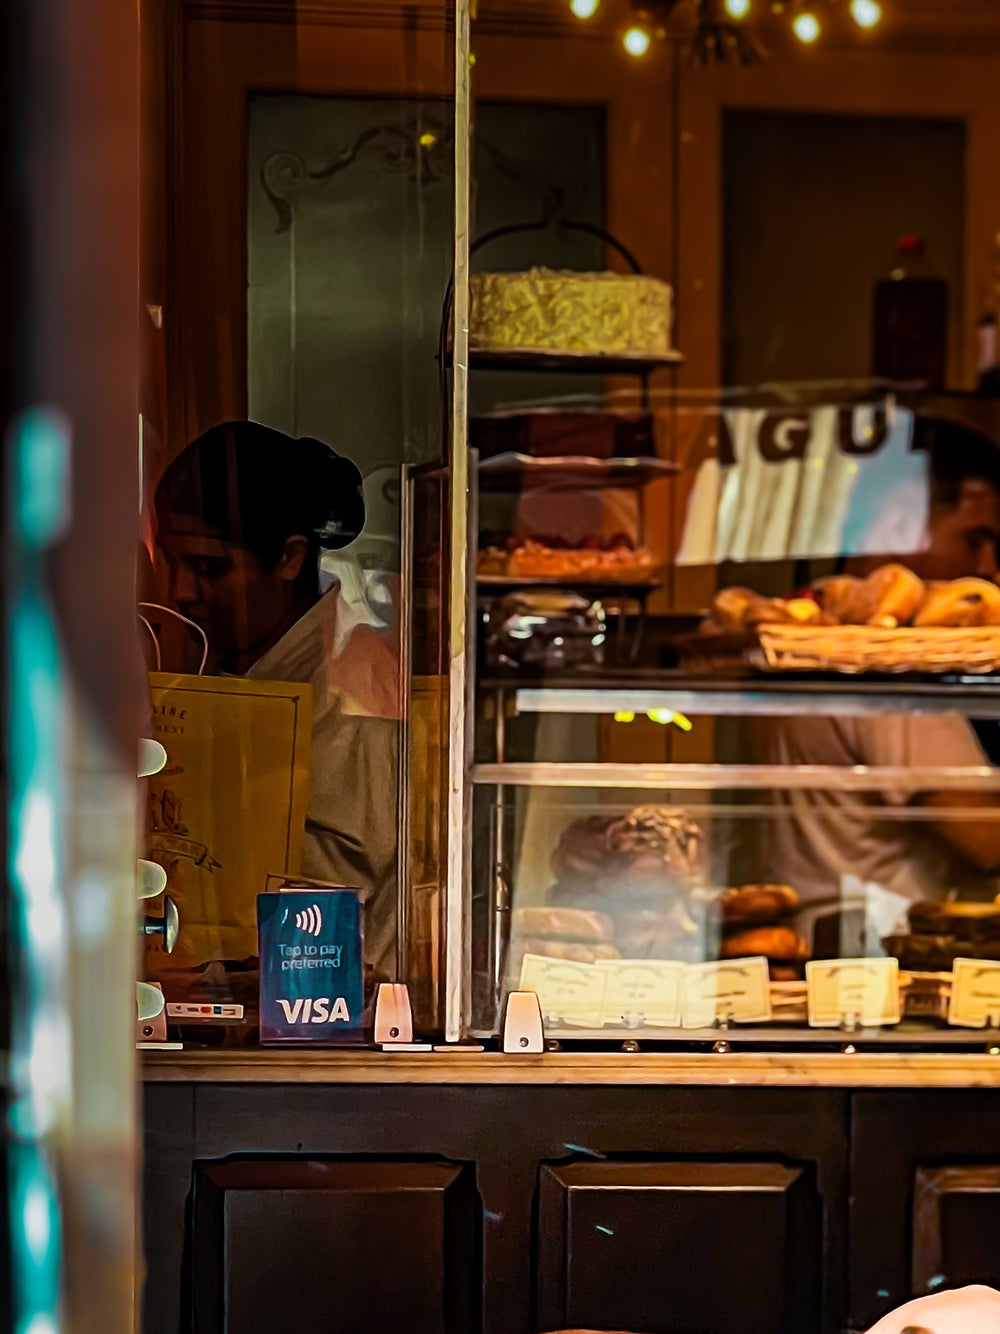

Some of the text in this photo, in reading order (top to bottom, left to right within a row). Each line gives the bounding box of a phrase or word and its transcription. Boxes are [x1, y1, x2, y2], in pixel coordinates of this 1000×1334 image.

[278, 943, 344, 958] Tap to pay
[281, 956, 342, 971] preferred
[275, 997, 350, 1024] VISA
